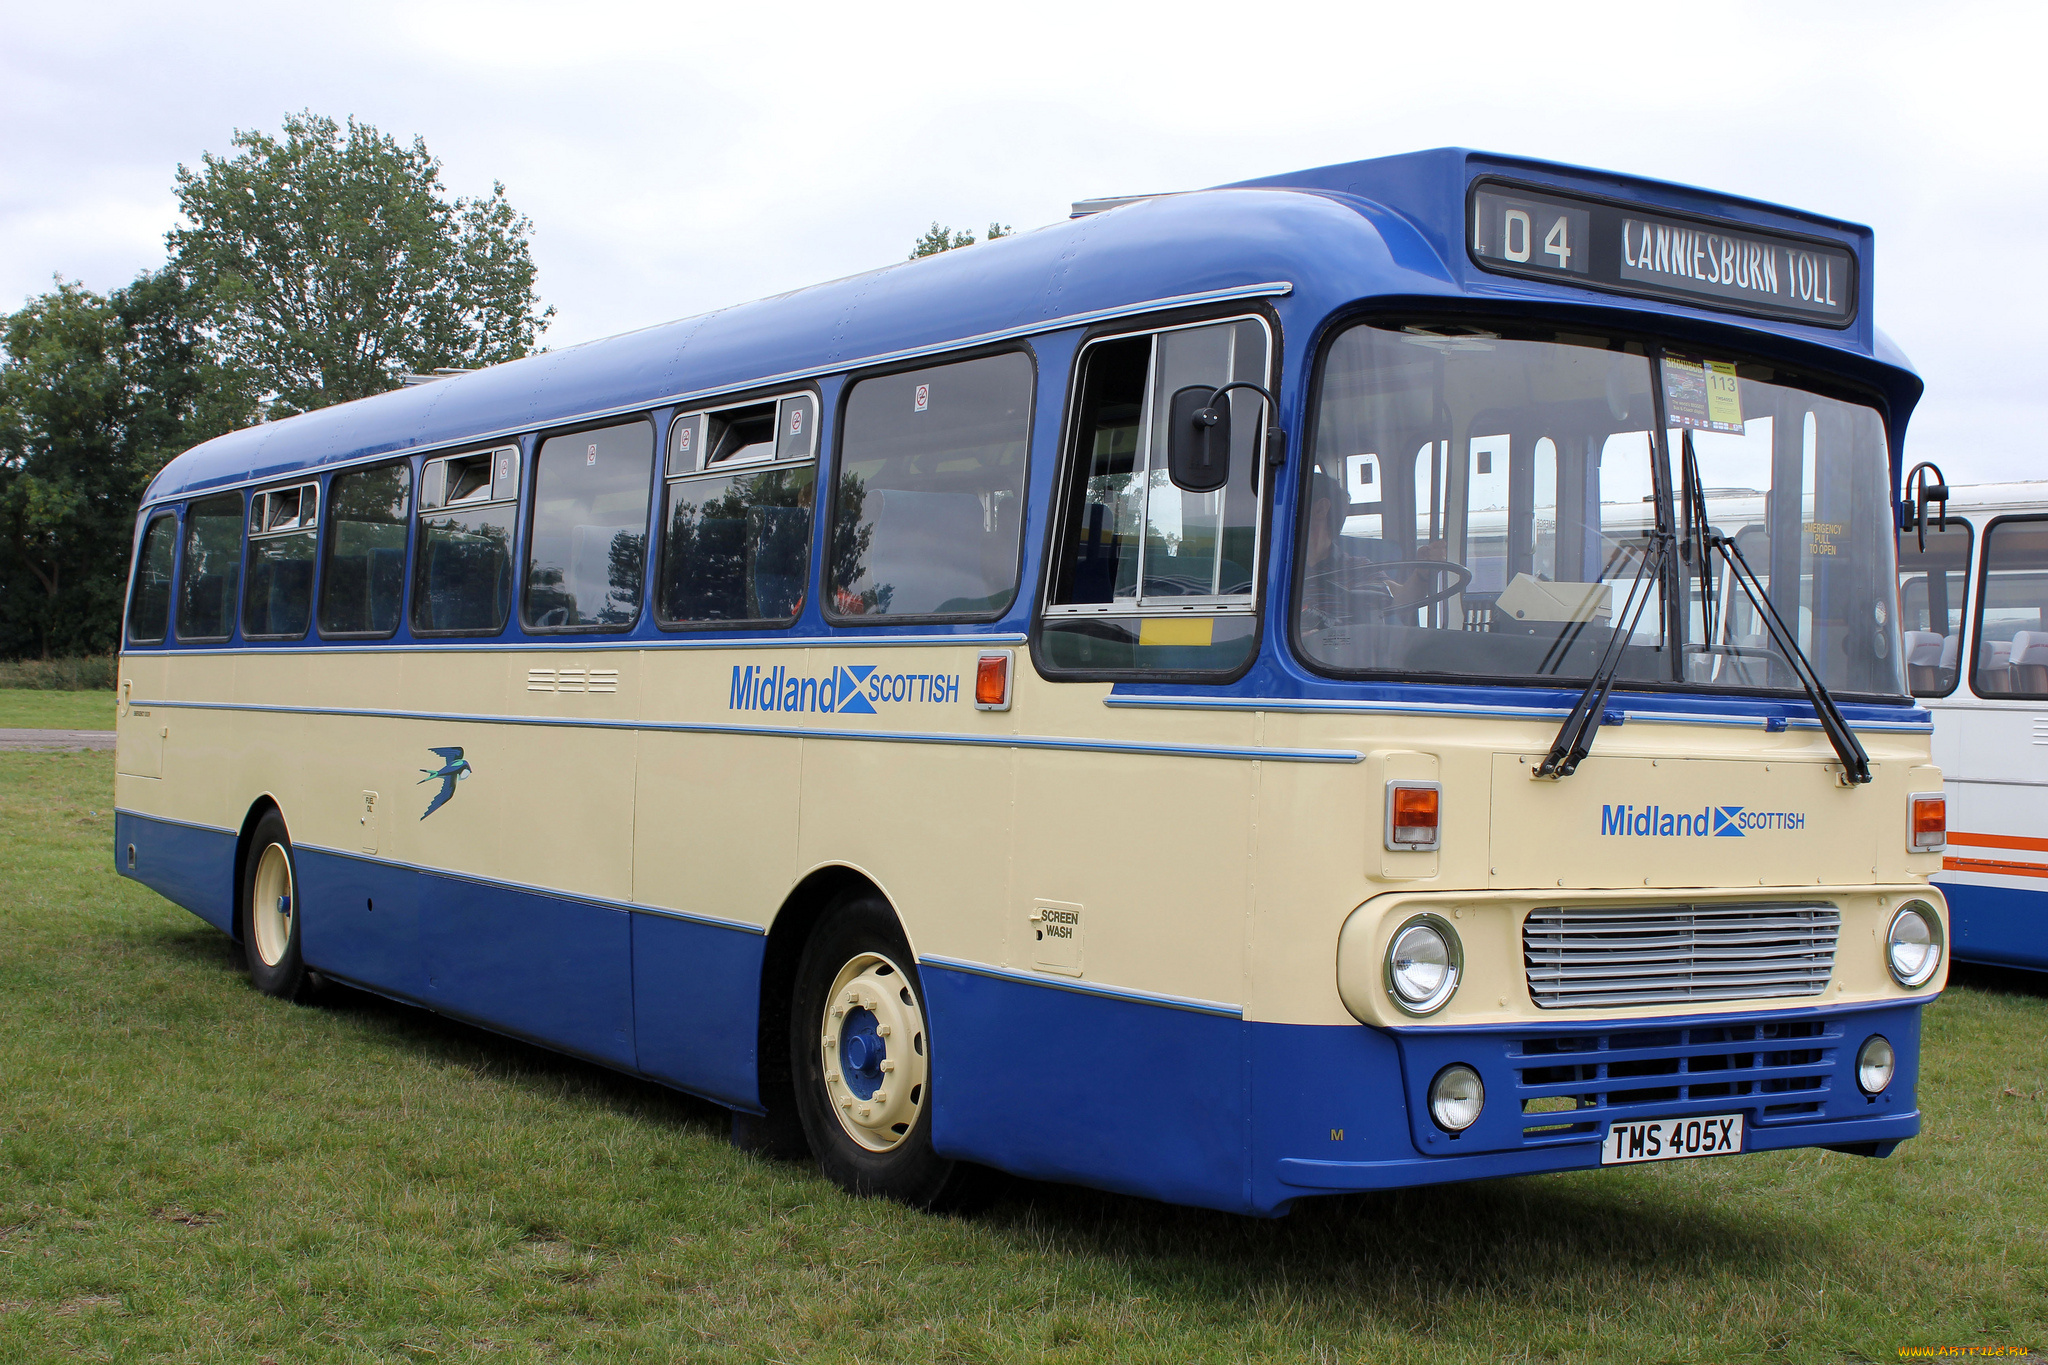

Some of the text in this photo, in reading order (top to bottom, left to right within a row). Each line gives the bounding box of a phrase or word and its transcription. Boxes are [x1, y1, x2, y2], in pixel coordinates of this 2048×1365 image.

[1623, 218, 1837, 307] CANNIESBURN TOLL
[1710, 375, 1736, 392] 113
[1803, 523, 1842, 535] EMERGENCY
[1814, 534, 1831, 545] PULL
[1809, 544, 1837, 555] TO OPEN
[728, 665, 960, 713] Midland SCOTTISH
[1601, 804, 1805, 837] Midland SCOTTISH
[1041, 909, 1079, 925] SCREEN
[1046, 924, 1073, 939] WASH
[1330, 1128, 1344, 1141] M
[1612, 1117, 1734, 1160] TMS 405X
